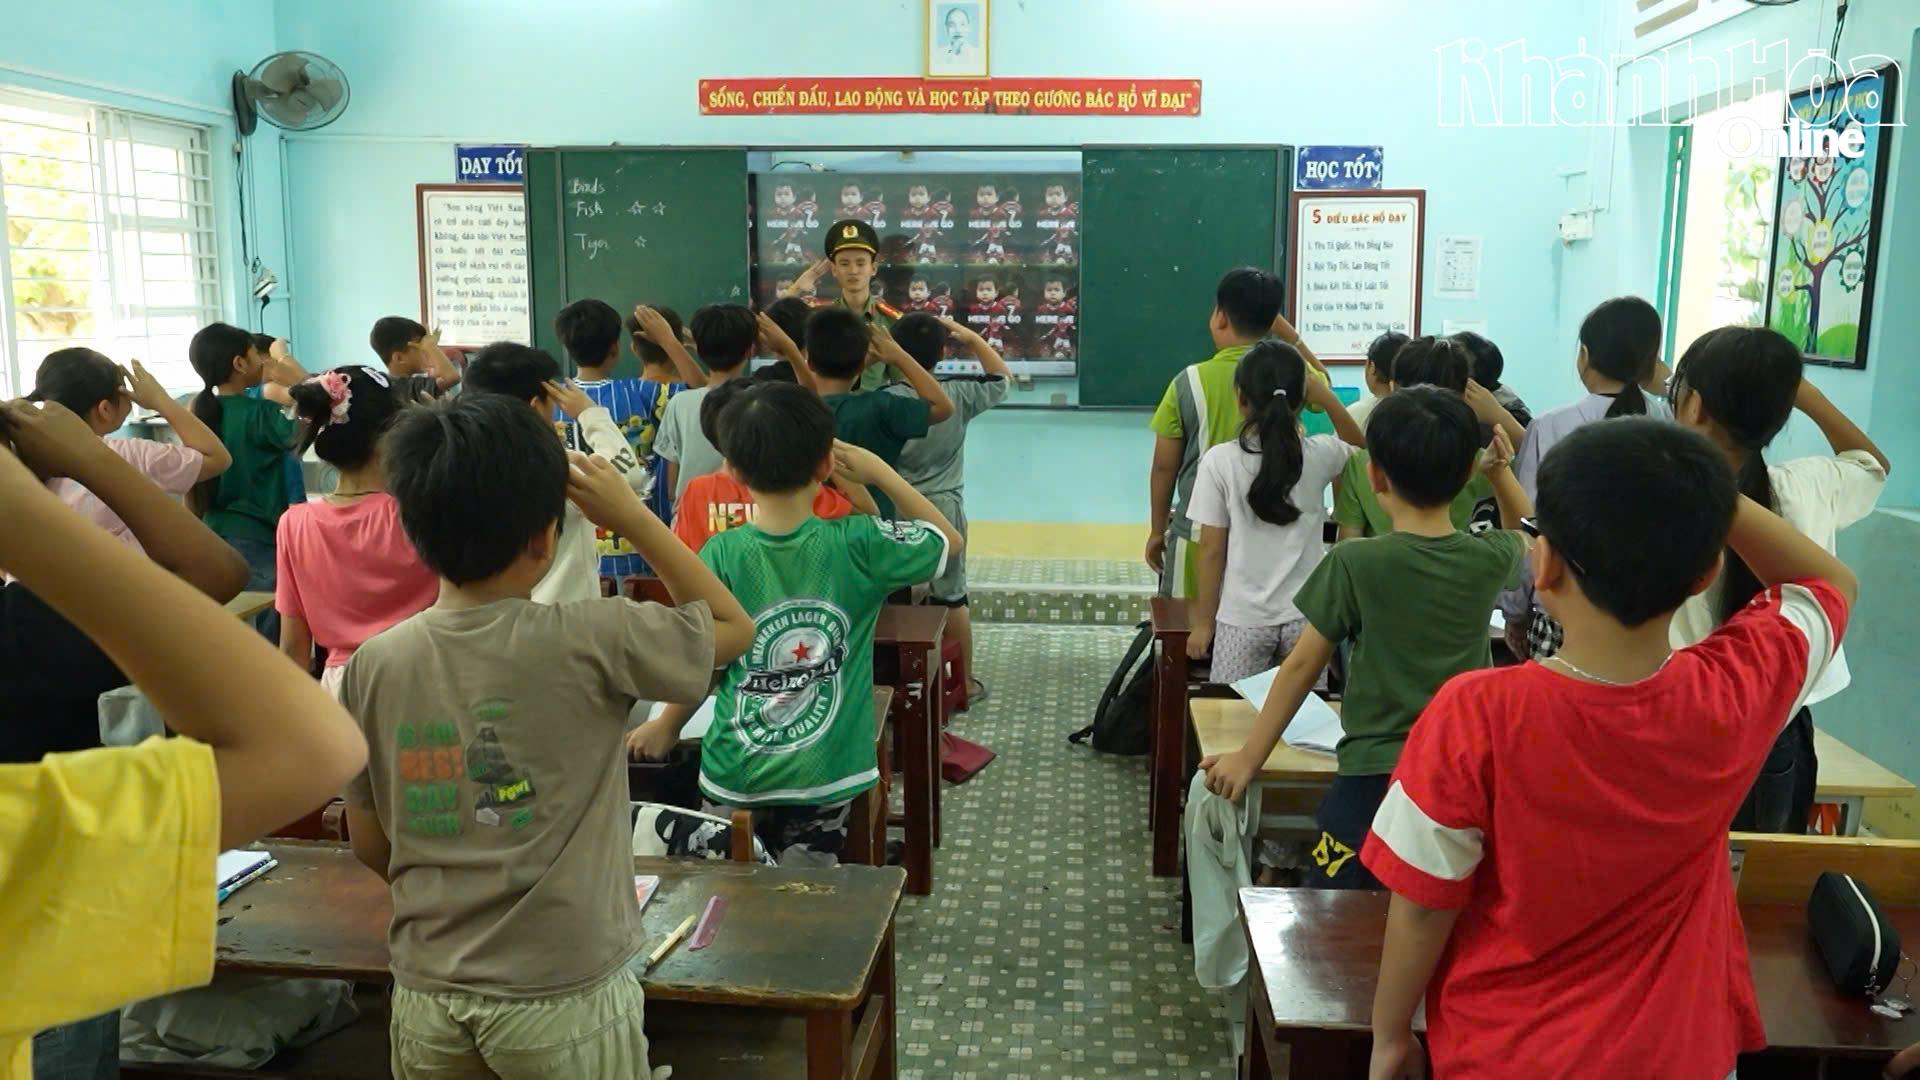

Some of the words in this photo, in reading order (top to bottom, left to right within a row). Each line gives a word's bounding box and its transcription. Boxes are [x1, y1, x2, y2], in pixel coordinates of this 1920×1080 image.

[709, 86, 749, 109] SỐNG,
[752, 84, 795, 107] CHIẾN
[799, 84, 831, 108] ĐẤU,
[834, 91, 861, 106] LAO
[865, 87, 903, 109] ĐỘNG
[907, 86, 926, 106] VÀ
[929, 91, 958, 109] HỌC
[963, 88, 989, 110] TẬP
[993, 91, 1030, 107] THEO
[1085, 86, 1113, 108] BÁC
[1117, 83, 1137, 109] HỒ
[1142, 89, 1158, 108] VĨ
[461, 157, 492, 178] DẠY
[1305, 161, 1339, 182] HỌC
[1343, 154, 1375, 178] TỐT
[576, 200, 604, 218] Fish
[1312, 209, 1322, 224] 5
[787, 695, 829, 738] QUALITY
